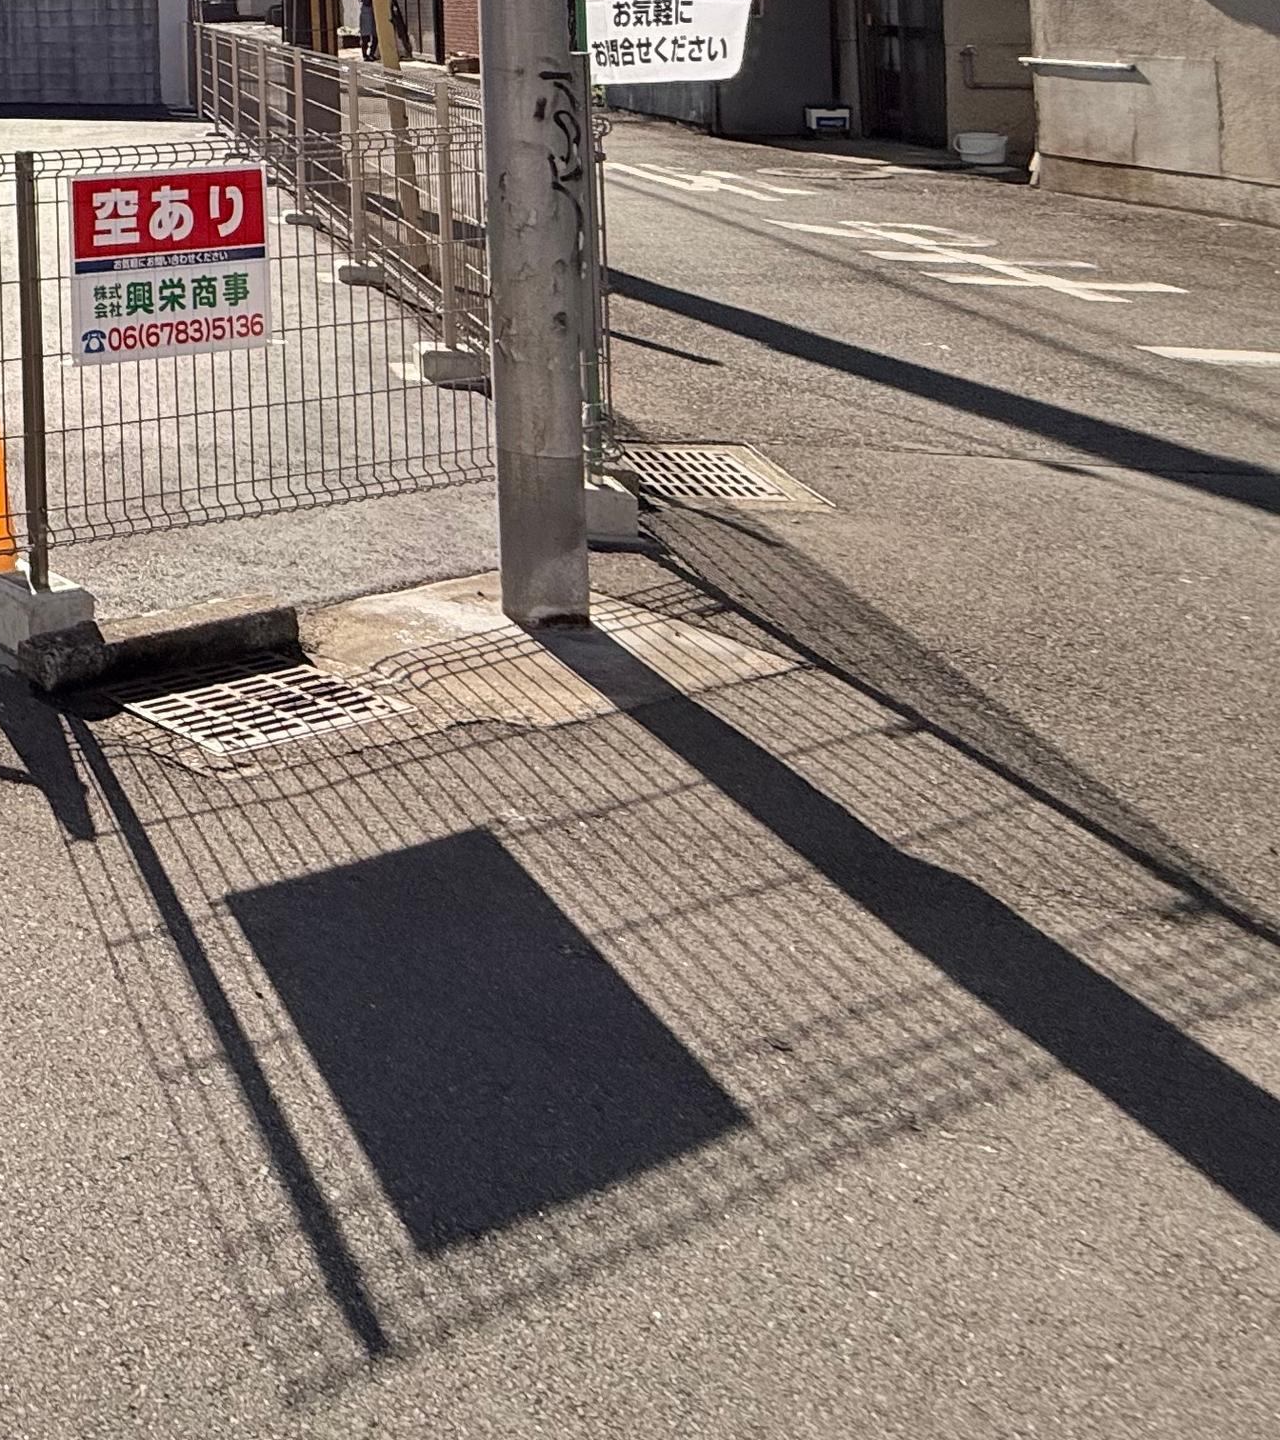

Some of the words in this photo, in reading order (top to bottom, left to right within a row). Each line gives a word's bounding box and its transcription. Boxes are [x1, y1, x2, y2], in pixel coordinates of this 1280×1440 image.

[591, 35, 727, 67] お問合せください
[92, 185, 244, 246] 空あり
[126, 272, 250, 316] 興栄商事
[108, 313, 264, 351] 06(6783)5136
